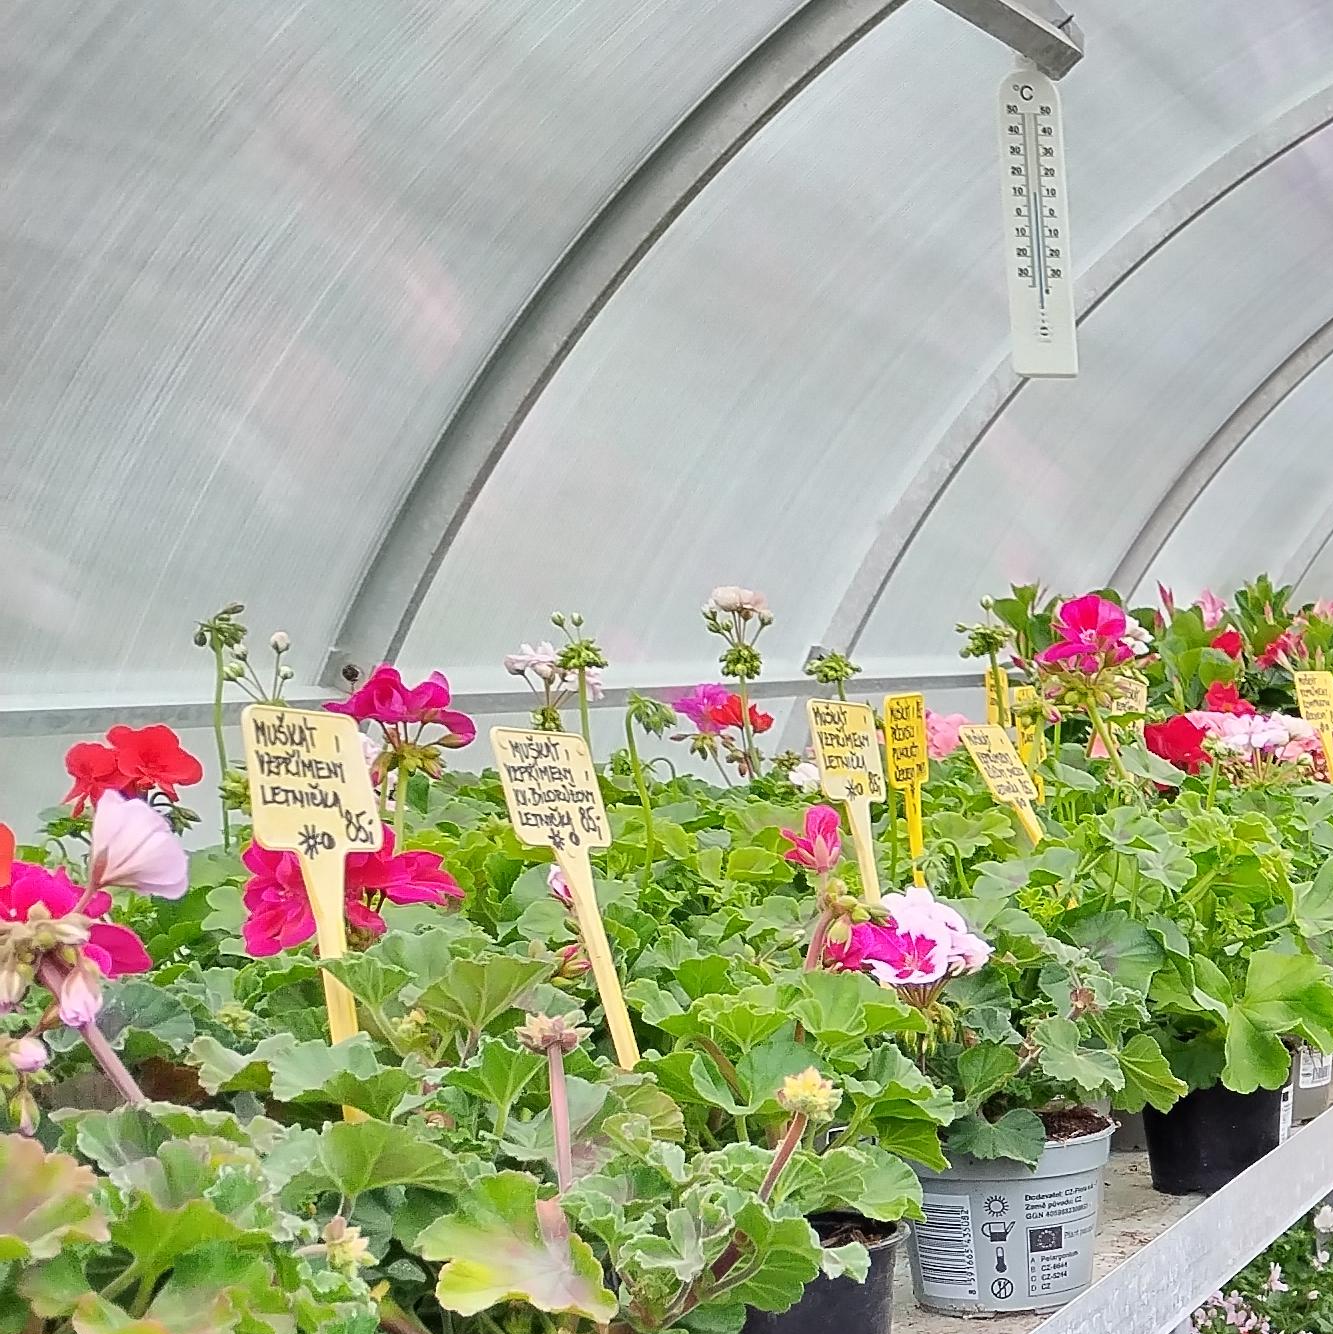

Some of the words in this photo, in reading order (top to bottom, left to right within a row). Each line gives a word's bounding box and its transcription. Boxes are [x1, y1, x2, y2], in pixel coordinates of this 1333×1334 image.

[1006, 104, 1018, 114] 50
[1040, 105, 1051, 116] 50
[1008, 125, 1020, 134] 40
[1041, 127, 1053, 136] 40
[1009, 145, 1021, 155] 30
[1042, 147, 1054, 157] 30
[1011, 166, 1022, 176] 20
[1044, 168, 1055, 176] 20
[1013, 187, 1023, 196] 10
[1046, 188, 1056, 196] 10
[1016, 208, 1022, 216] 0
[1048, 208, 1055, 216] 0
[1016, 227, 1026, 236] 10
[1048, 229, 1059, 237] 10
[1016, 248, 1027, 257] 20
[1049, 249, 1060, 257] 20
[1018, 268, 1029, 277] 30
[1050, 269, 1061, 278] 30
[960, 1209, 972, 1244] 435082
